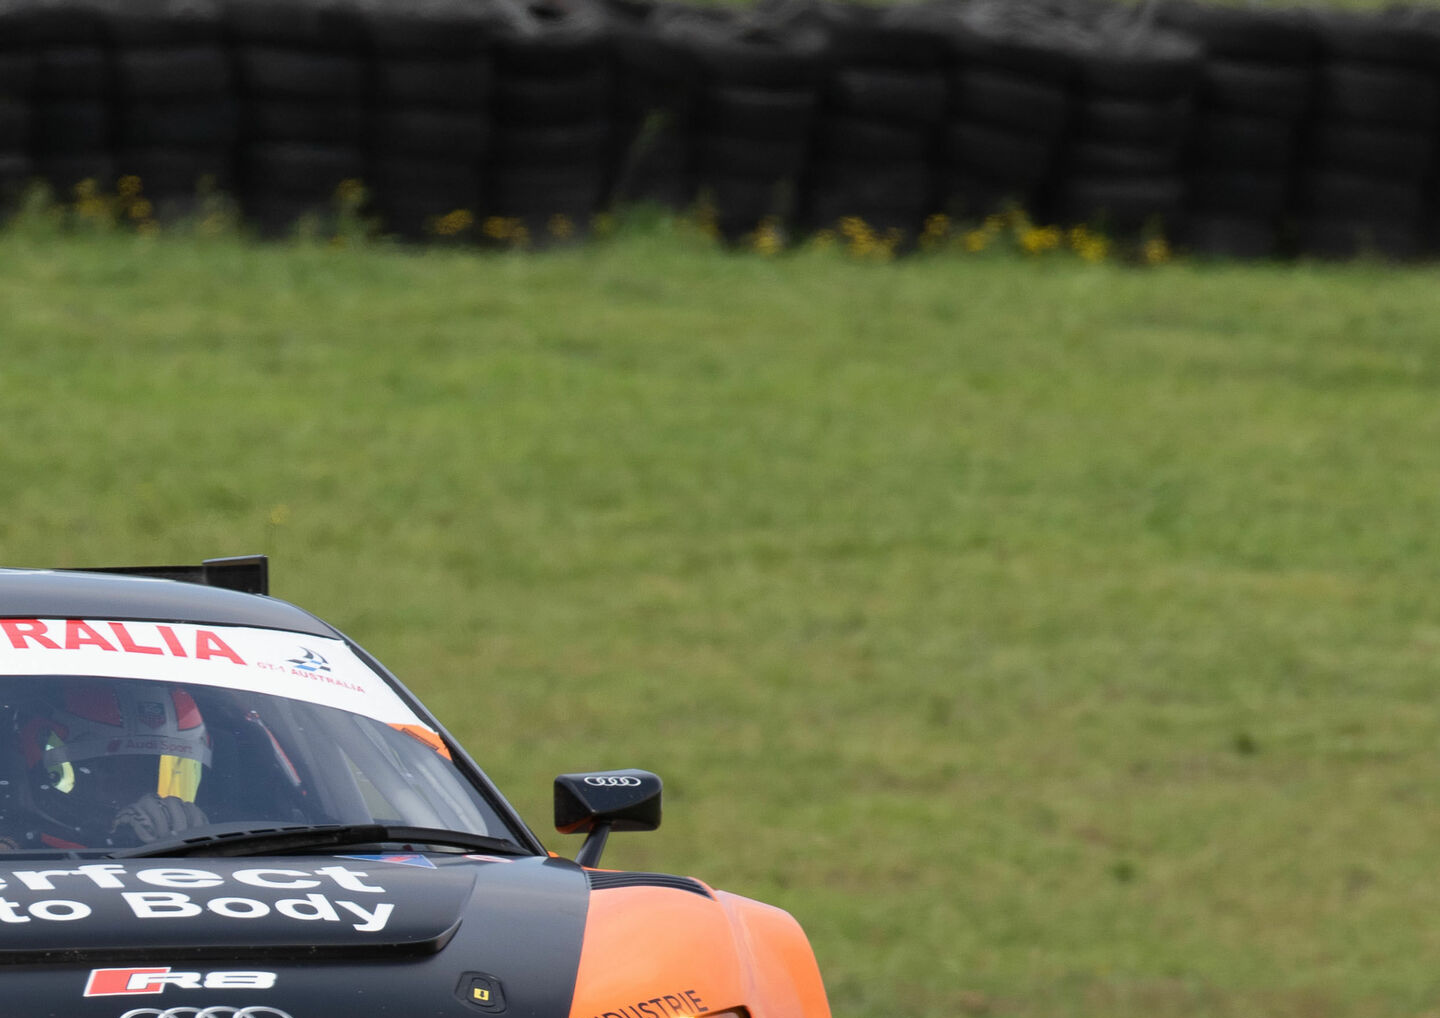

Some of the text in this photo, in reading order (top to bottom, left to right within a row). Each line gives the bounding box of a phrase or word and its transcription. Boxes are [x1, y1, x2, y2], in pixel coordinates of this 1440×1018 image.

[291, 668, 366, 694] AUSTRALIA
[120, 890, 395, 933] Body
[126, 971, 278, 990] R8
